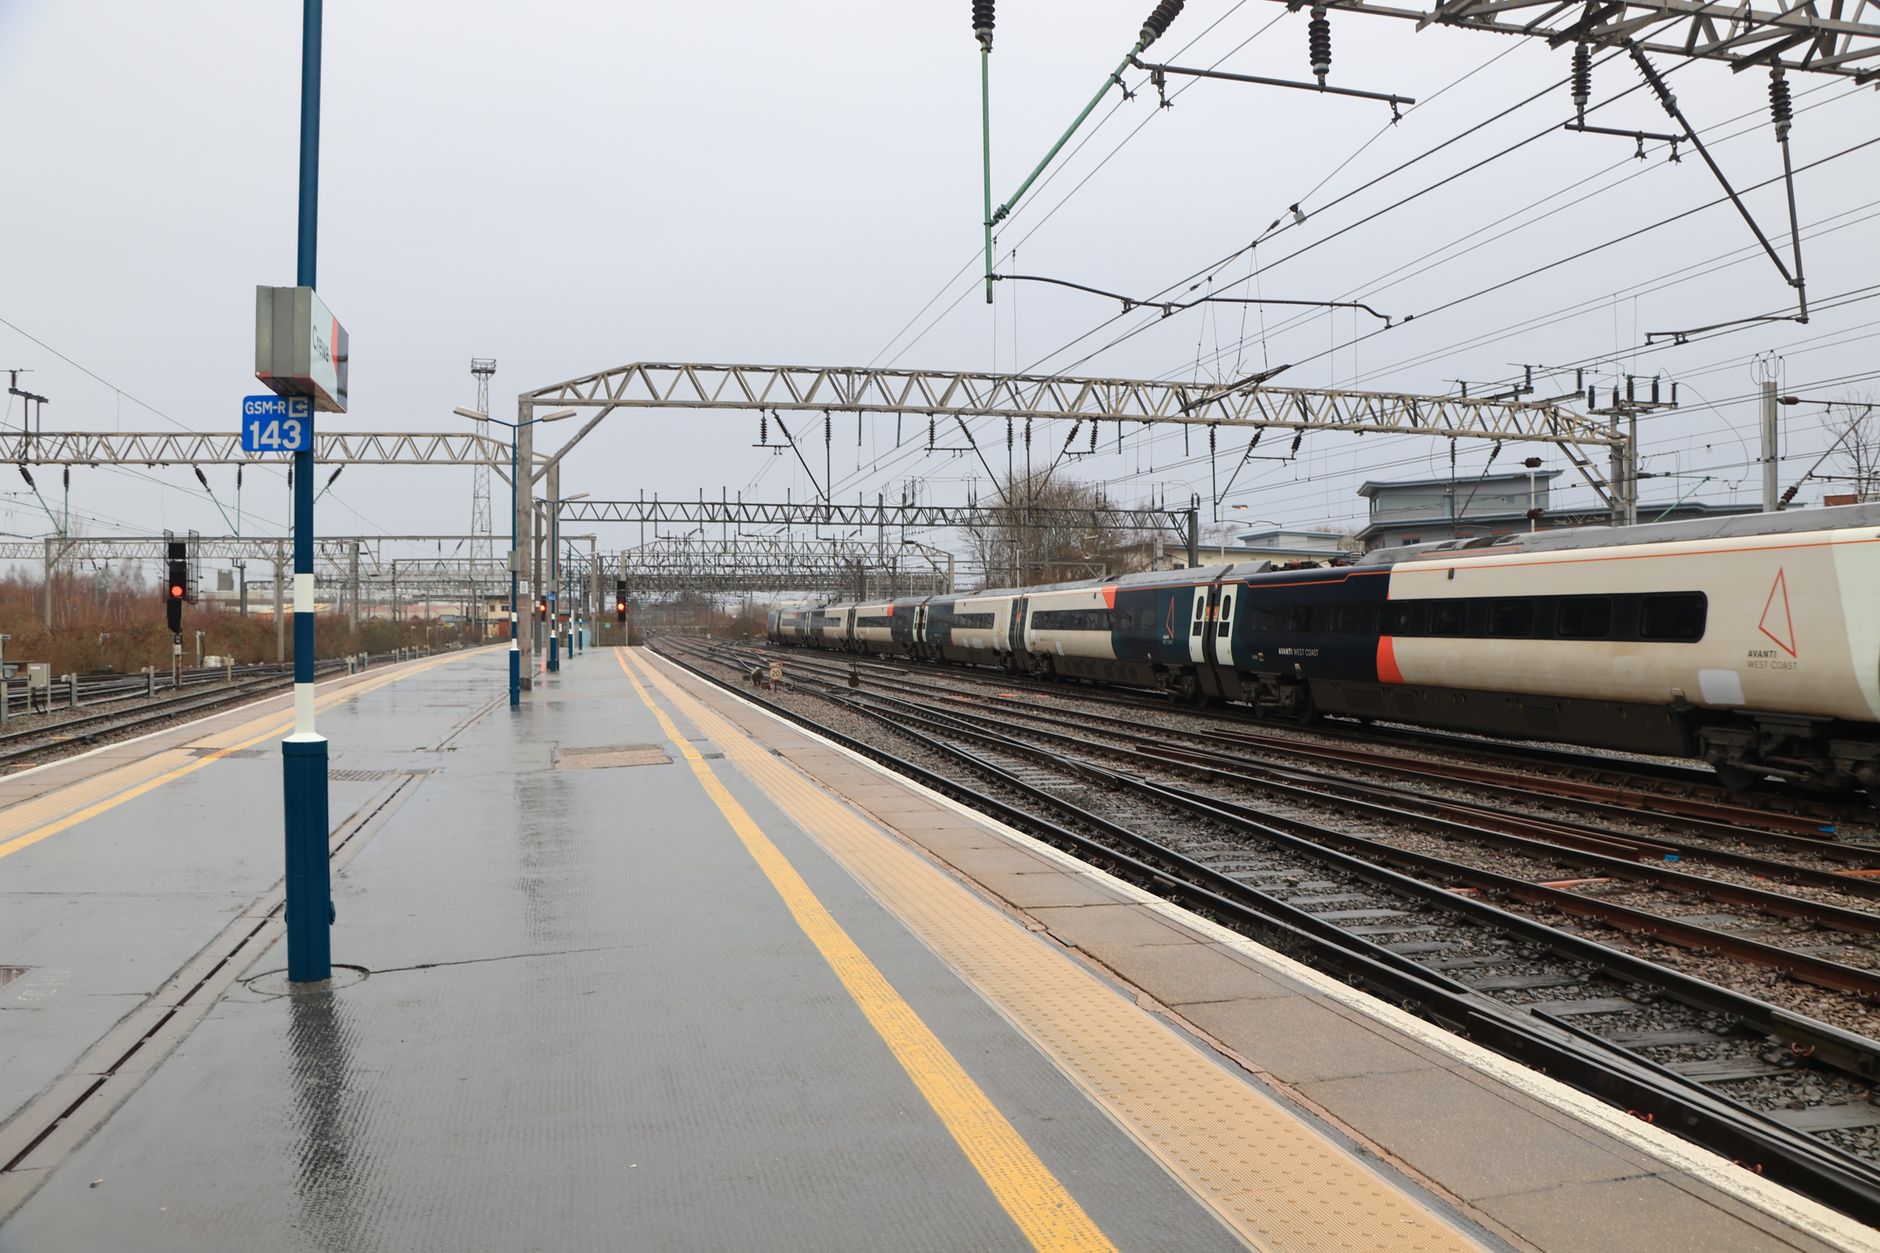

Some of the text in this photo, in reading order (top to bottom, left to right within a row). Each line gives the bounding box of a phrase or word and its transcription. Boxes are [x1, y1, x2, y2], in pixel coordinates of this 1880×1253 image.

[245, 401, 286, 415] GSM-R
[250, 420, 301, 449] 143
[1748, 650, 1777, 658] AVANTI
[1747, 660, 1797, 670] WEST COAST
